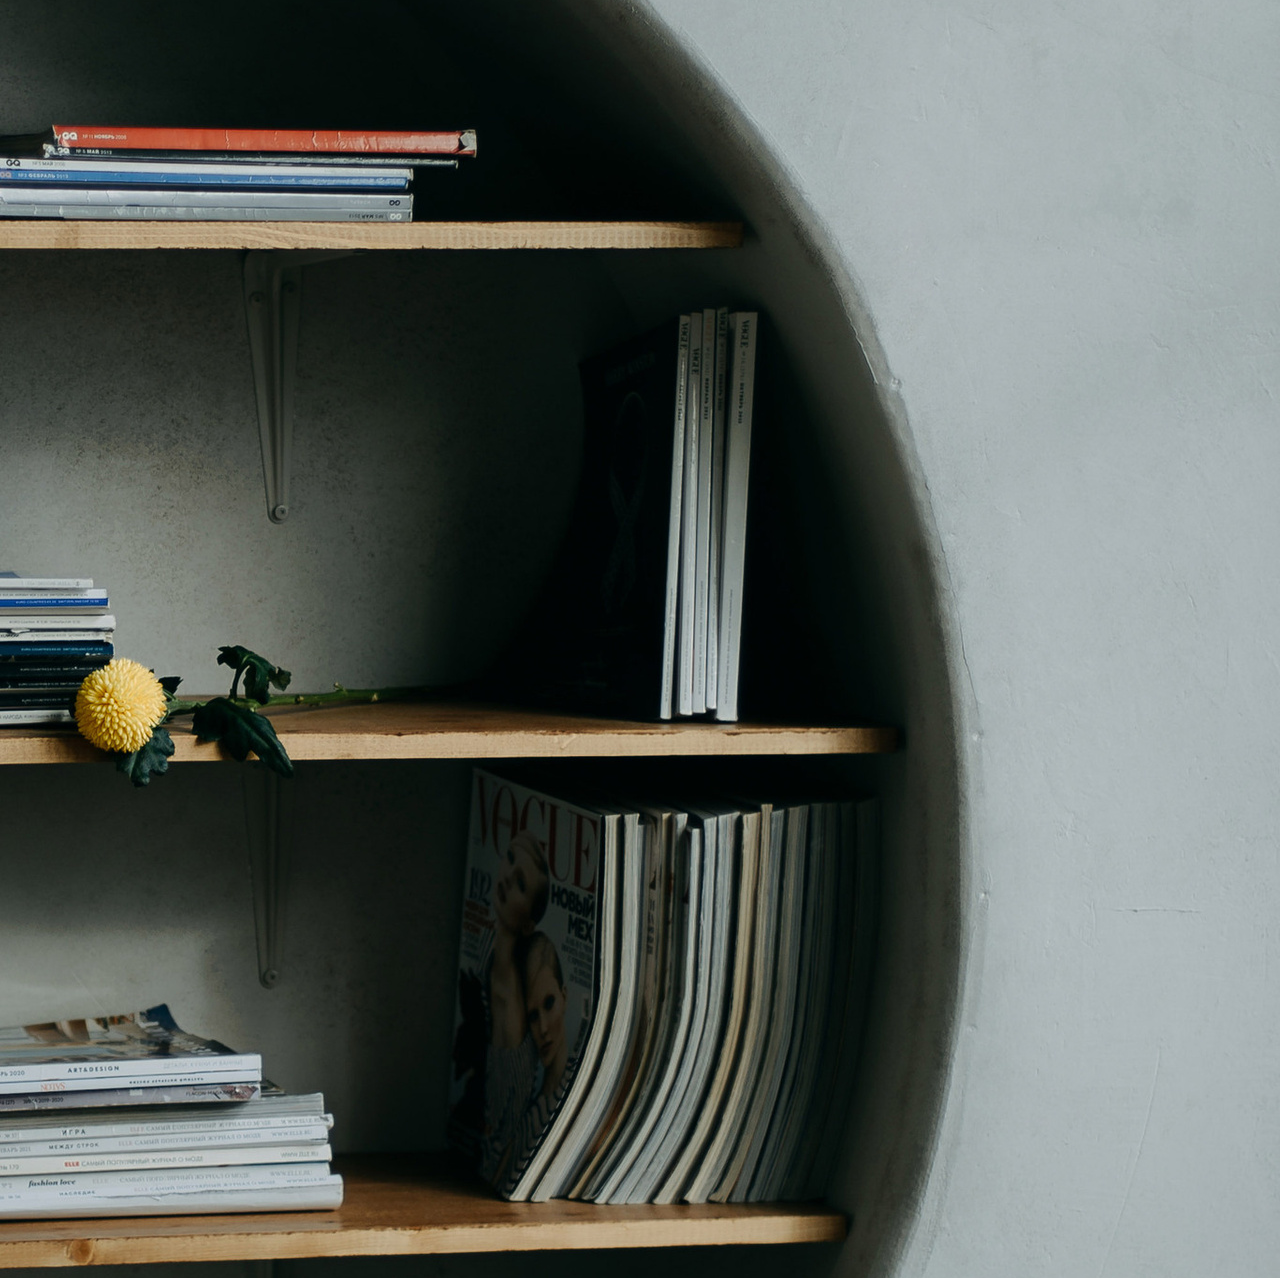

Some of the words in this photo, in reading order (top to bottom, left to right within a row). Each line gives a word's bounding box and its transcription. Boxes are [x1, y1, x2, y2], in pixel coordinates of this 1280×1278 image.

[62, 132, 78, 140] GQ
[680, 322, 688, 350] VOGUE
[719, 312, 728, 340] VOGUE
[740, 320, 750, 348] VOGUE
[692, 348, 700, 375] VOGUE
[477, 774, 598, 894] VOGUE
[551, 883, 595, 920] НОВЫЙ
[568, 914, 594, 944] МЕХ
[40, 1082, 65, 1091] SALON
[171, 1122, 216, 1130] ПОПУЛЯРНЫЙ
[160, 1136, 206, 1144] ПОПУЛЯРНЫЙ
[28, 1180, 58, 1188] fashion
